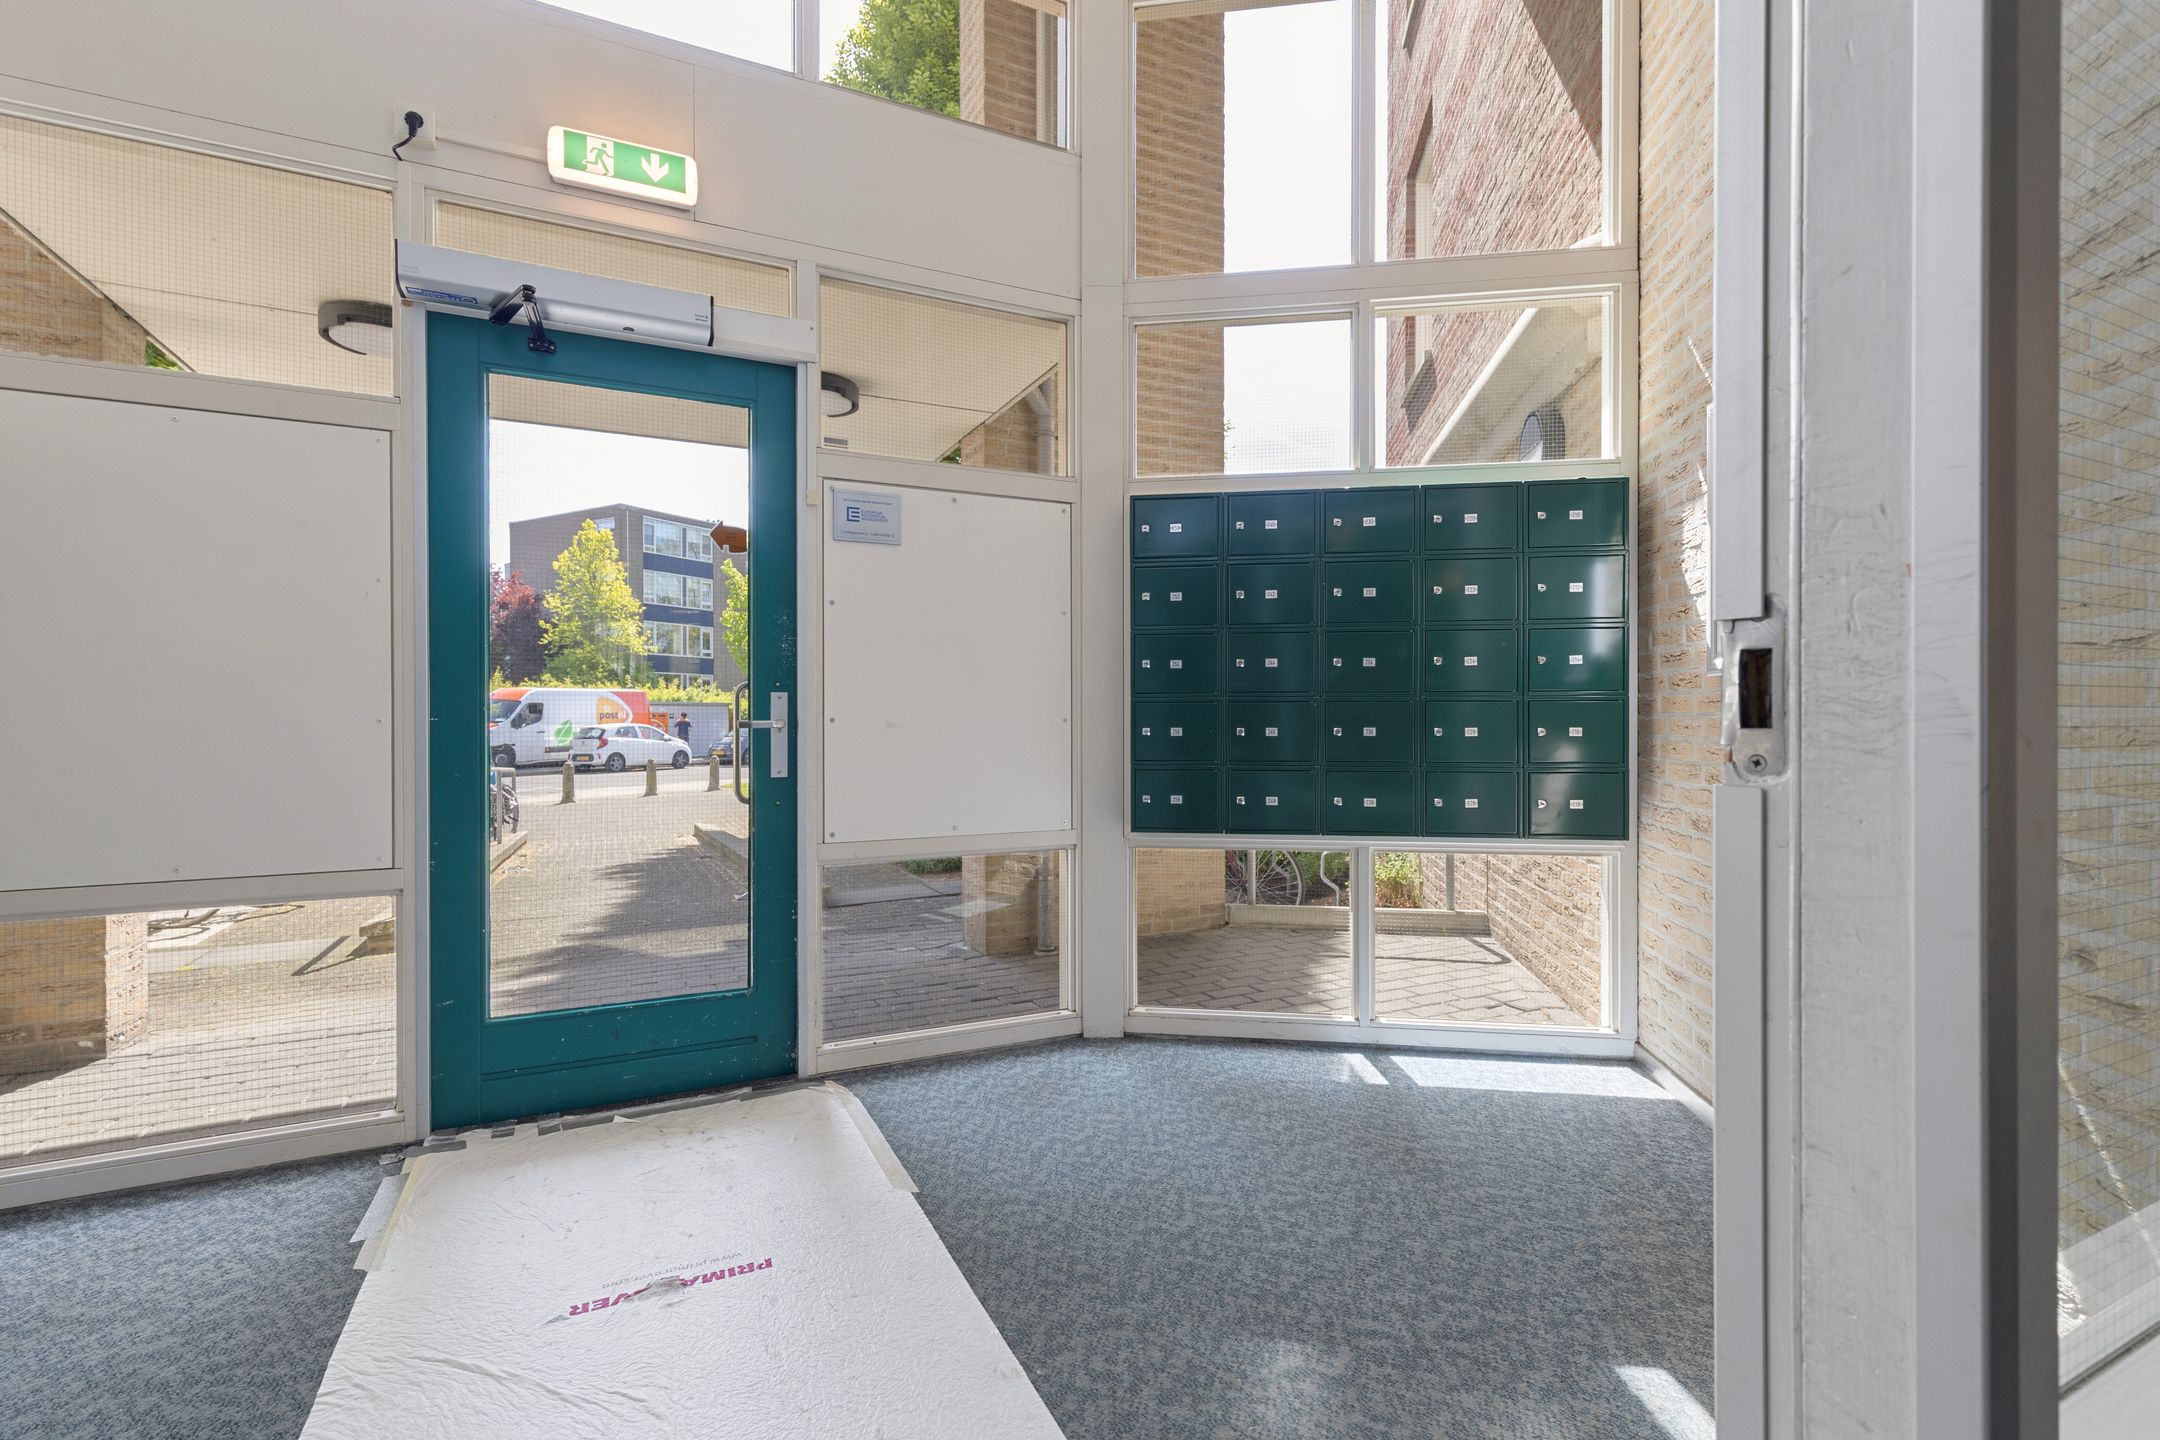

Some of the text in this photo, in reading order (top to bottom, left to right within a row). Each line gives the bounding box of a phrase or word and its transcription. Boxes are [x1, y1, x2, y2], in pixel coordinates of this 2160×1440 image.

[599, 710, 626, 720] postnl
[569, 1258, 773, 1316] PRIMAVER
[602, 1253, 743, 1290] www.primacover.com
